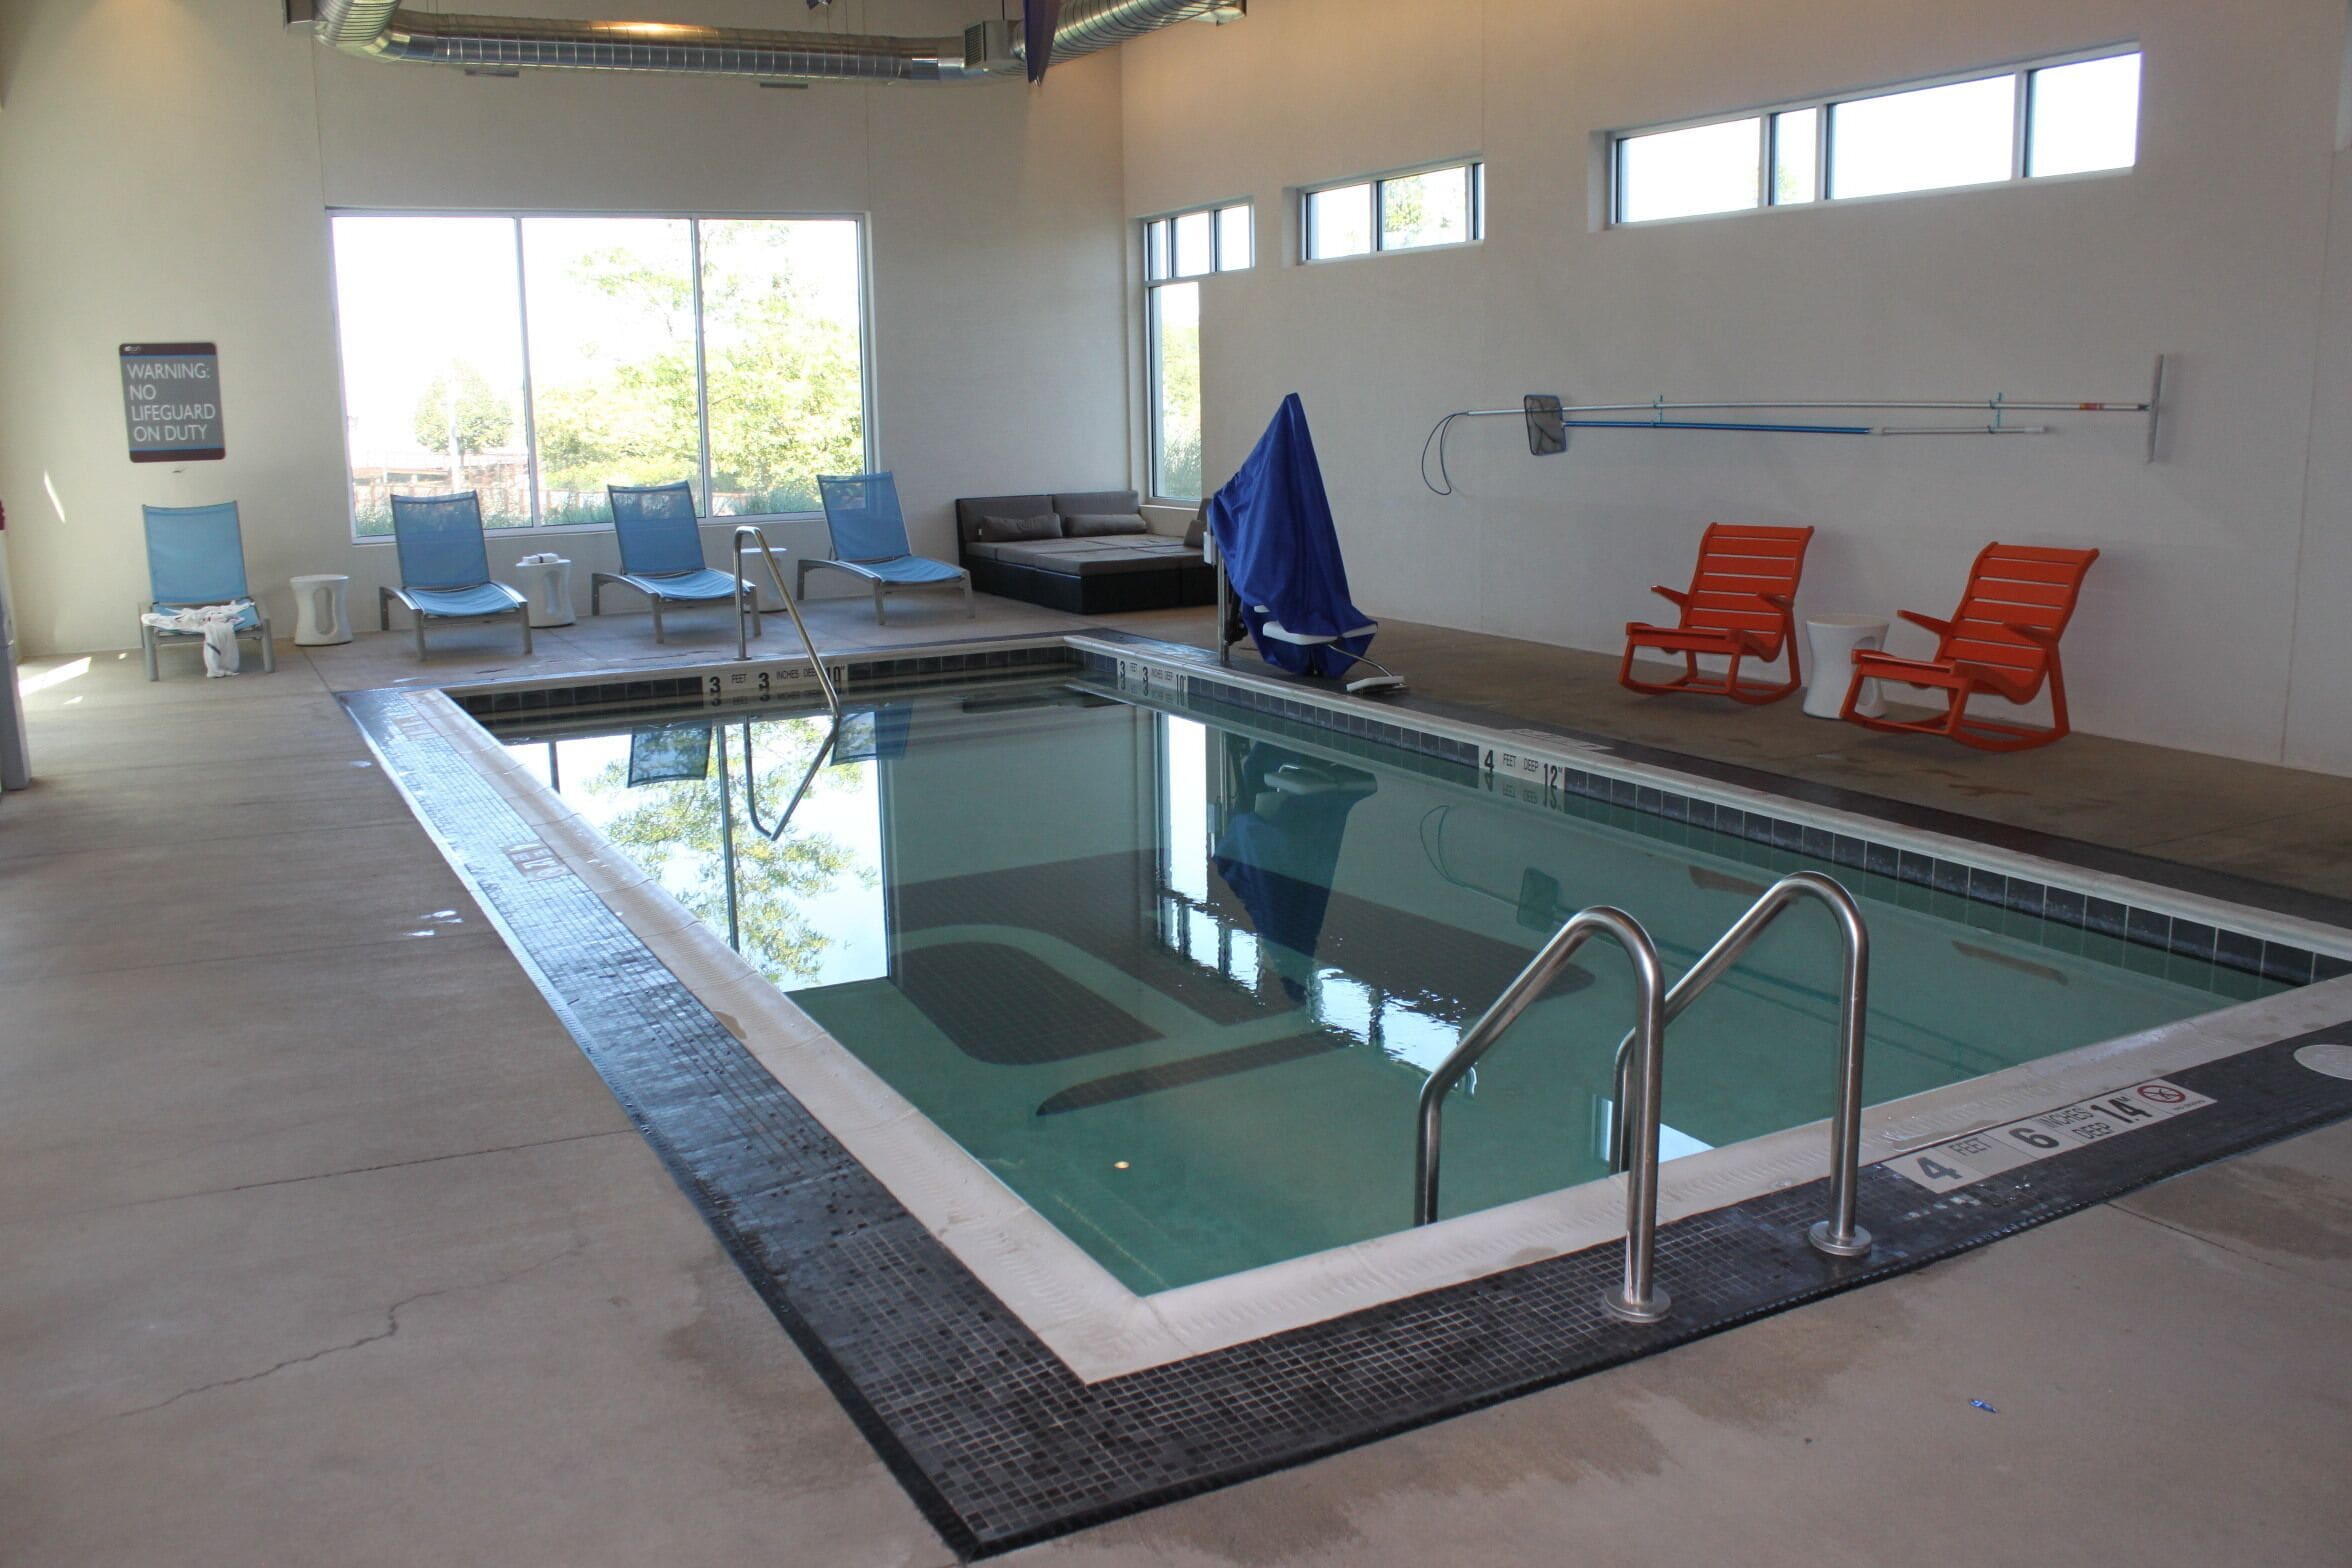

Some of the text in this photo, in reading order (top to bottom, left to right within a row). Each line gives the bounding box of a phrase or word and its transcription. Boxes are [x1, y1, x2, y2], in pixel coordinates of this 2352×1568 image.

[127, 363, 210, 379] WARNING:
[129, 384, 156, 400] NO
[131, 404, 216, 421] LIFEGUARD
[133, 424, 208, 442] ON DUTY
[1120, 661, 1126, 677] 3
[1142, 666, 1149, 681] 3
[709, 676, 721, 693] 3
[731, 673, 747, 684] FEET
[758, 672, 770, 689] 3
[1484, 749, 1495, 773] 4
[1503, 752, 1517, 768] FEET
[1523, 758, 1539, 772] DEEP
[1916, 1156, 1963, 1180] 4
[1949, 1136, 1992, 1157] FEET
[2008, 1127, 2060, 1149] 6
[2039, 1107, 2094, 1130] INCHES
[2072, 1122, 2116, 1140] DEEP
